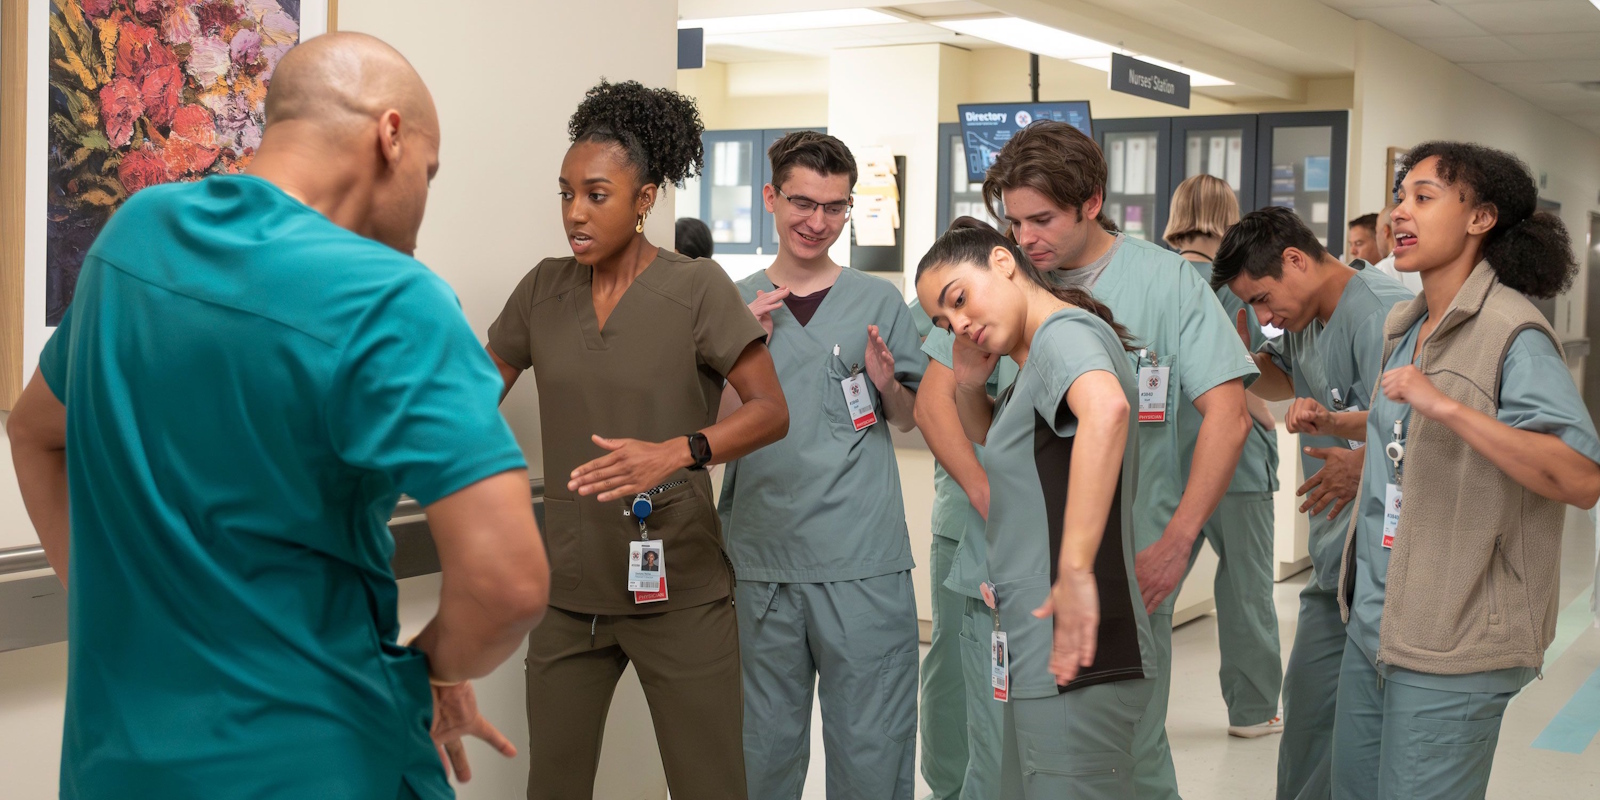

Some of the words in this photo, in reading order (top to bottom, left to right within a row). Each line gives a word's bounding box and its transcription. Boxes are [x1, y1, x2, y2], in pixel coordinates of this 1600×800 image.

[1128, 68, 1153, 89] Nurses'
[1153, 75, 1175, 95] Station
[965, 111, 1007, 124] Directory
[638, 592, 665, 600] PHYSICIAN
